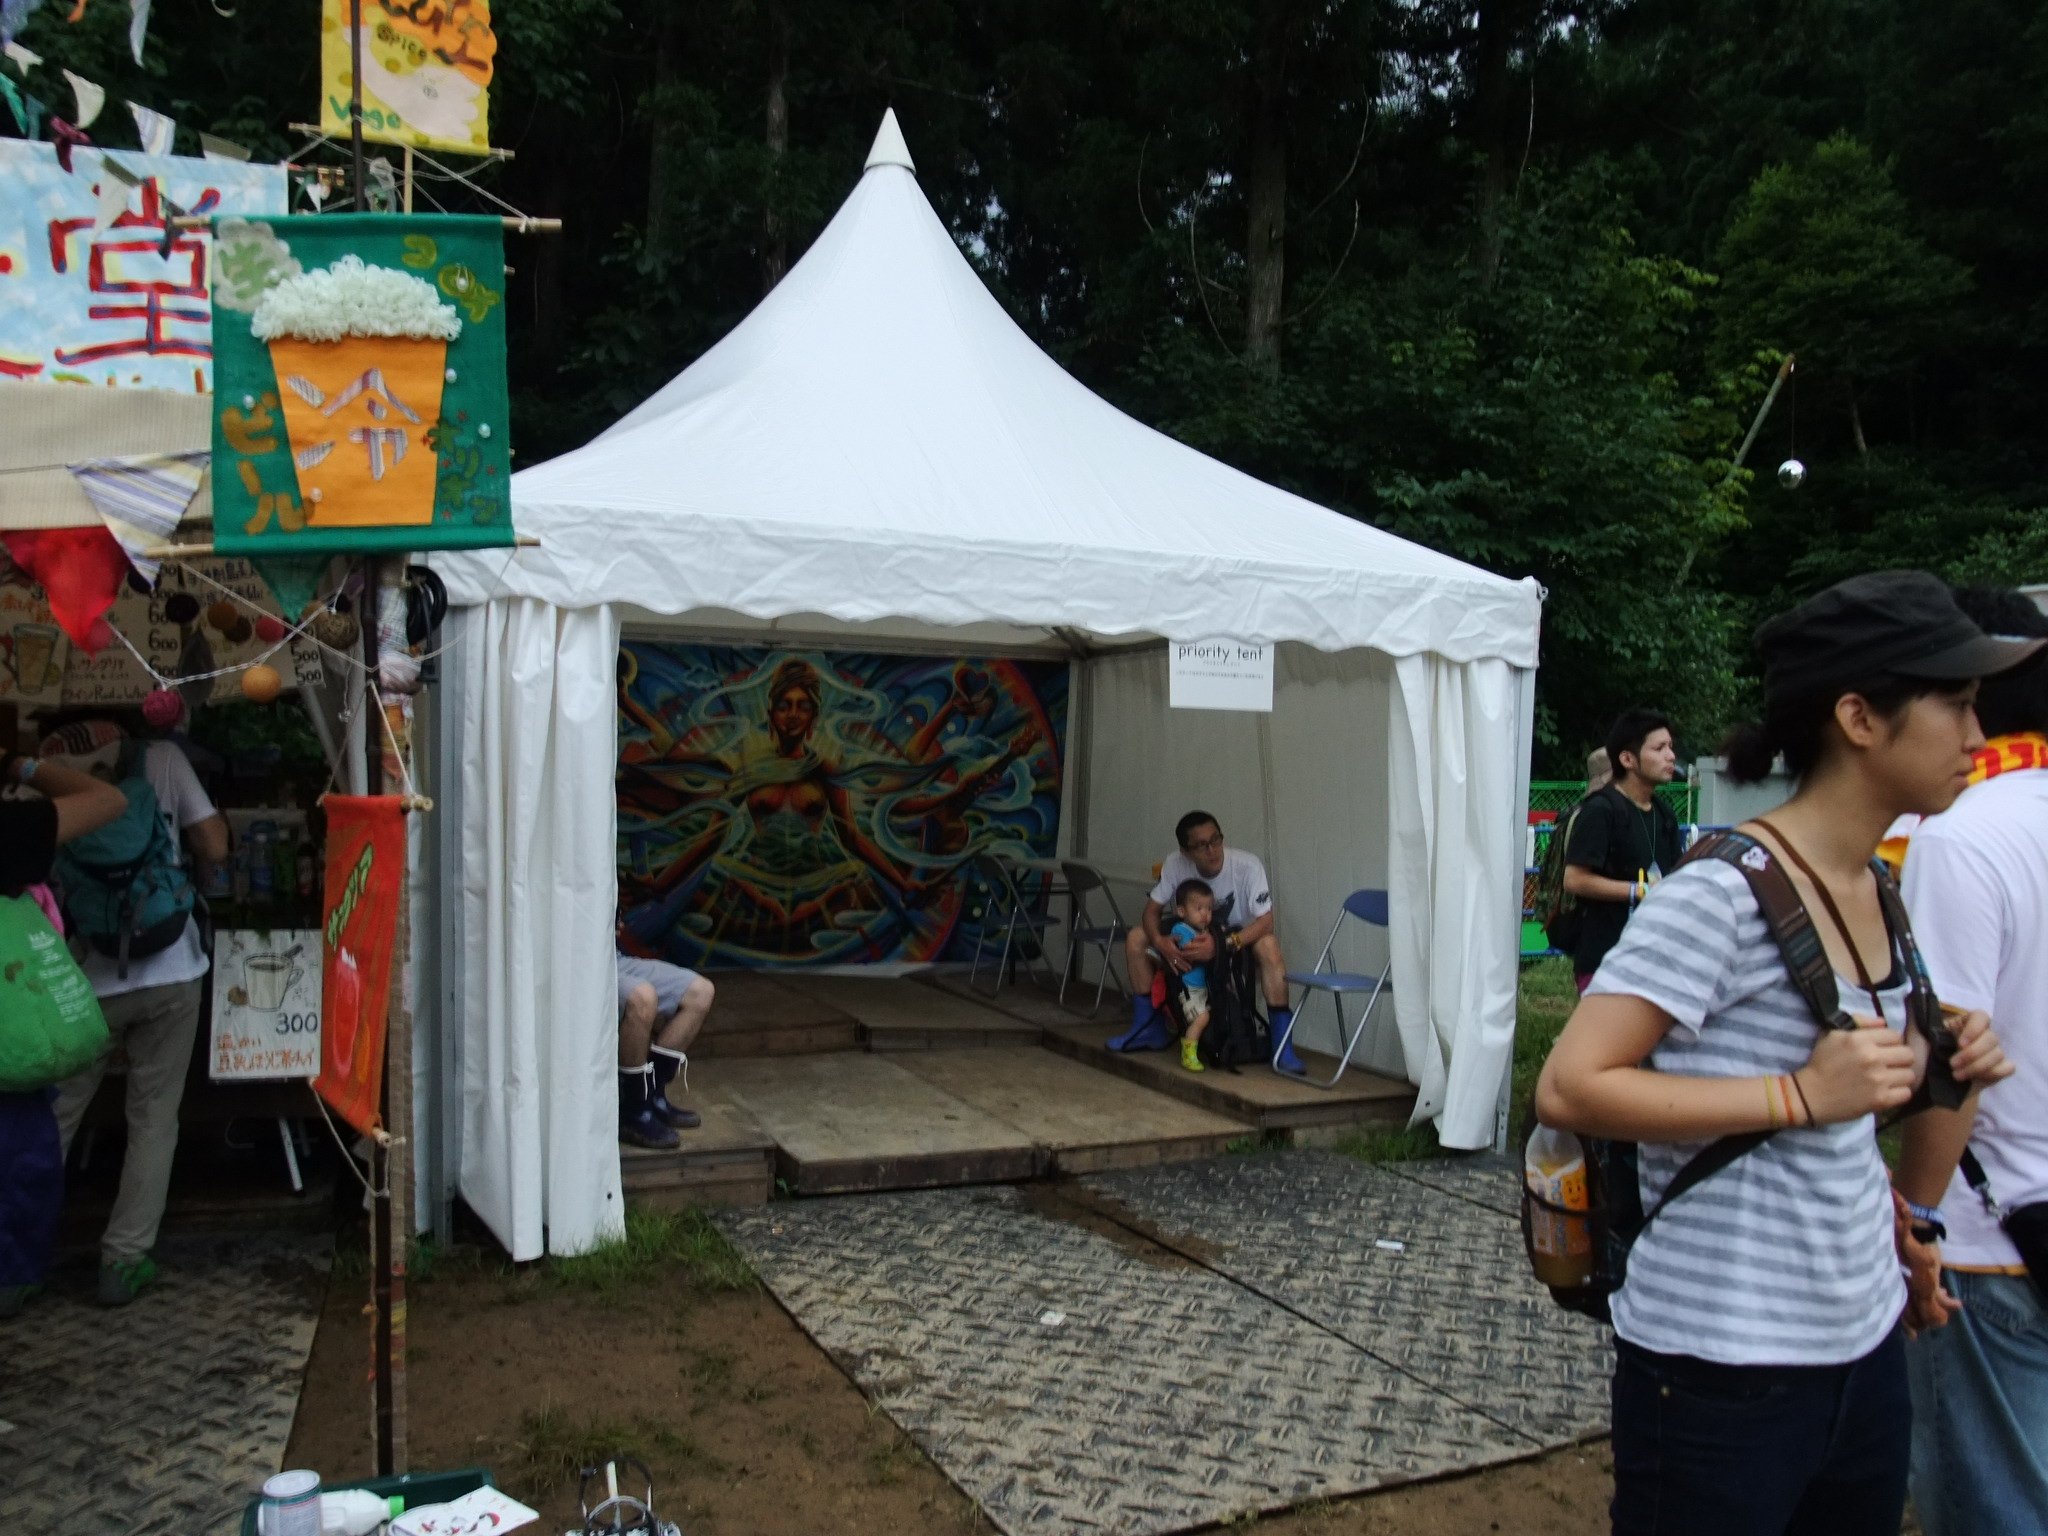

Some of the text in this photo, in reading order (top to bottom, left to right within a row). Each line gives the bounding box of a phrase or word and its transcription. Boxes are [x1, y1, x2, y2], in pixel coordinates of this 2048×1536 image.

[1178, 642, 1264, 663] priority tent
[275, 1011, 318, 1035] 300
